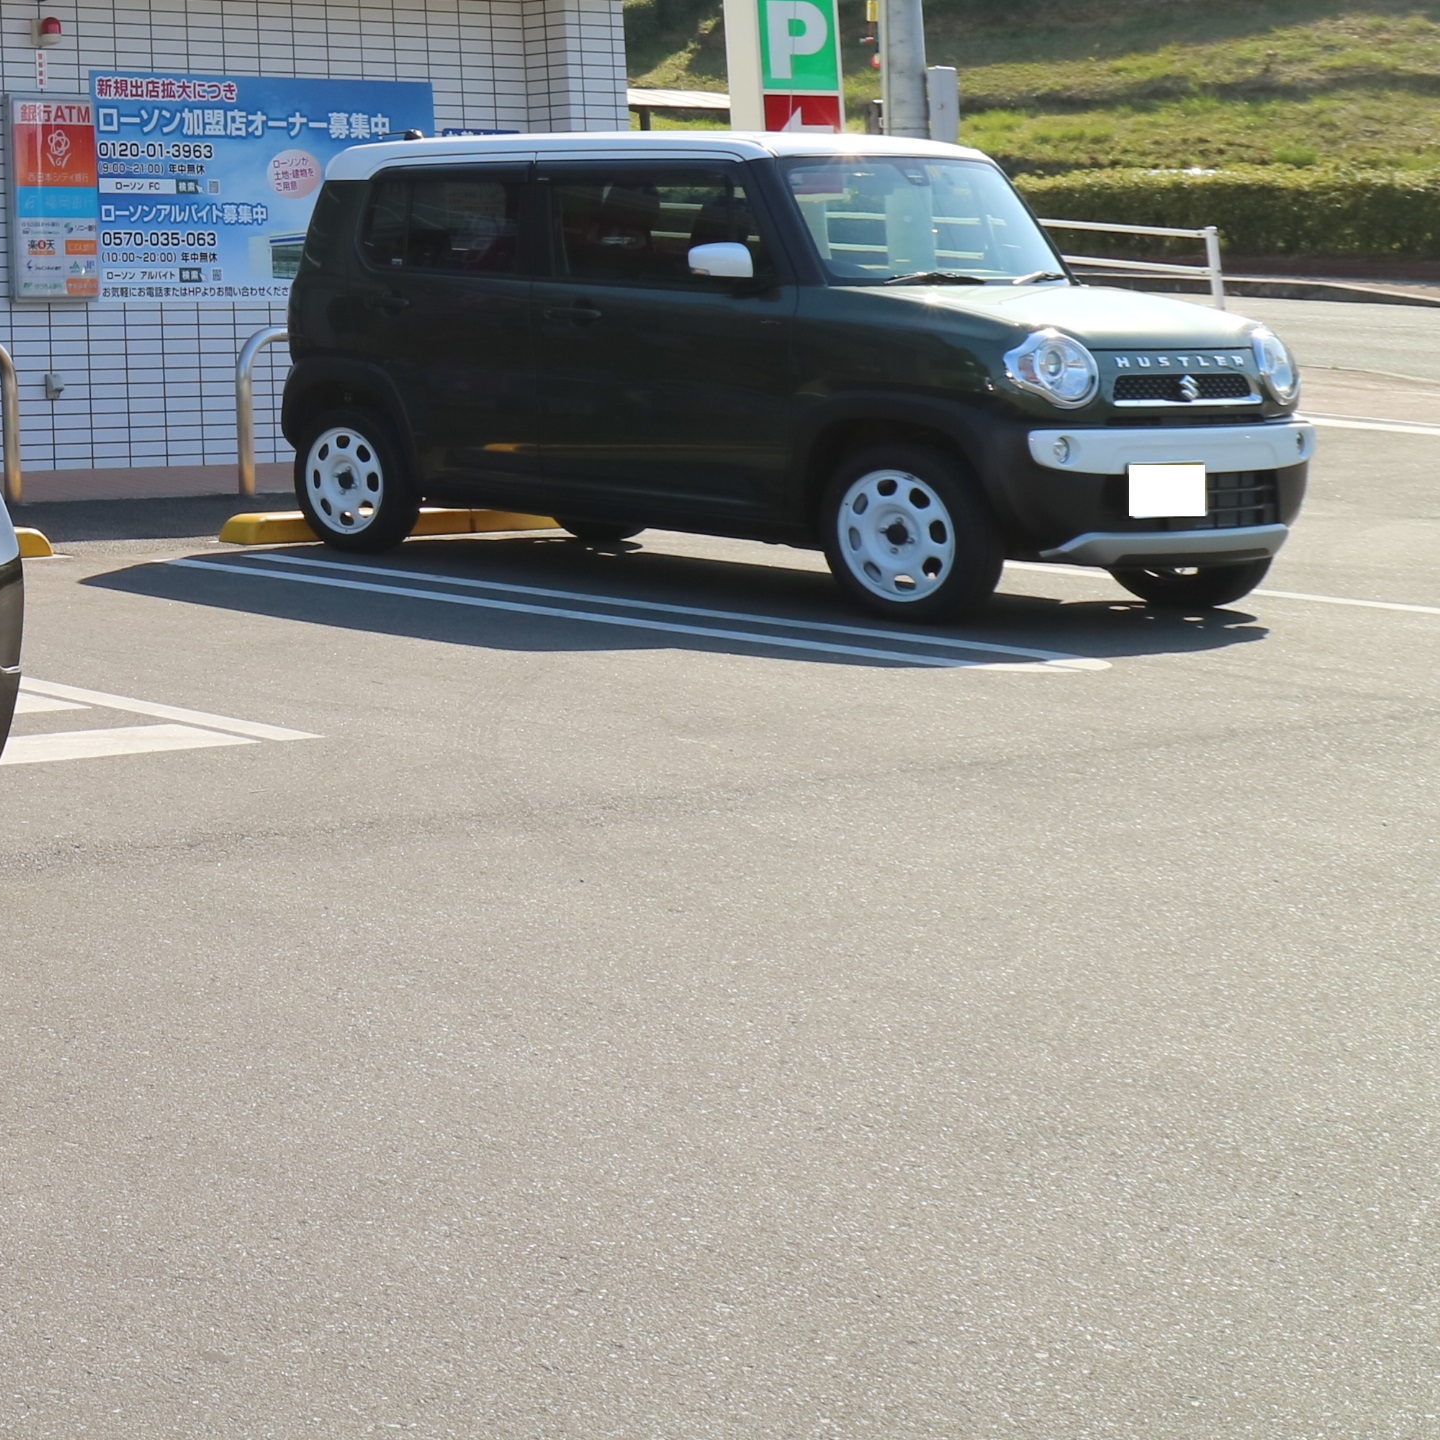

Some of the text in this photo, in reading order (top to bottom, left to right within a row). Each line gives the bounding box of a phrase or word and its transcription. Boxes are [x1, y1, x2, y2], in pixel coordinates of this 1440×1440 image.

[766, 0, 828, 79] P
[96, 78, 238, 101] 新規出店拡大につき
[21, 103, 91, 123] 銀行ATM
[98, 108, 391, 140] ローソン加盟店オーナー募集中
[98, 142, 214, 159] 0120-01-3963
[273, 156, 309, 168] ローソンが
[168, 163, 206, 175] 年中無休
[115, 181, 197, 193] ローソン FC 検索
[275, 181, 298, 192] ご用意
[101, 204, 268, 225] ローソンアルバイト募集中
[102, 231, 217, 247] 0570-035-063
[180, 252, 218, 264] 年中無休
[106, 270, 201, 282] ローソン アルバイト 検索
[102, 286, 290, 298] お気軽にお電話またはHPよりお問い合わせくださ
[1114, 355, 1245, 368] HUSTLER
